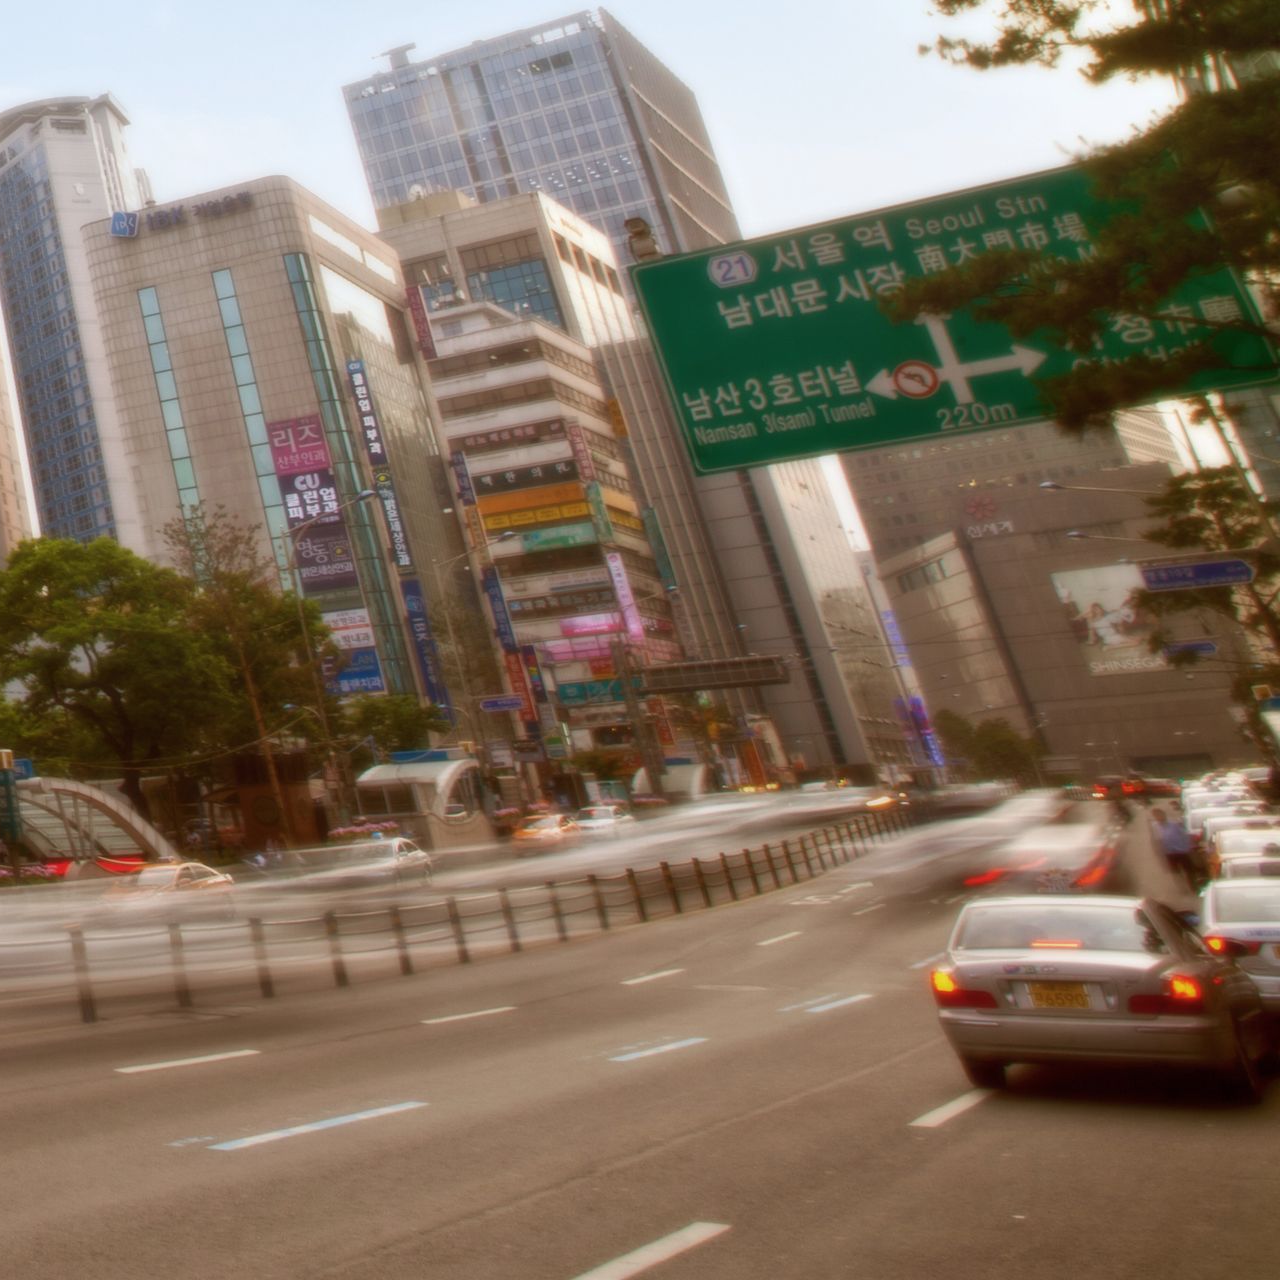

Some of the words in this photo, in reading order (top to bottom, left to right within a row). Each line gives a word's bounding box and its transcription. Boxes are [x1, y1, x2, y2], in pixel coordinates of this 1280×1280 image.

[905, 205, 985, 239] Seoul
[994, 194, 1048, 219] Stn
[913, 212, 1089, 275] 南大門市場
[716, 256, 751, 283] 21
[693, 421, 759, 446] Namsan
[761, 407, 817, 434] 3(sam)
[817, 396, 877, 424] Tunnel
[936, 402, 1018, 430] 220m
[271, 424, 323, 454] 리즈
[362, 415, 383, 455] 피부과
[276, 449, 327, 470] 산부인과
[293, 473, 321, 491] CU
[285, 487, 337, 508] 클린업
[287, 500, 339, 520] 피부과
[296, 538, 331, 564] 명동
